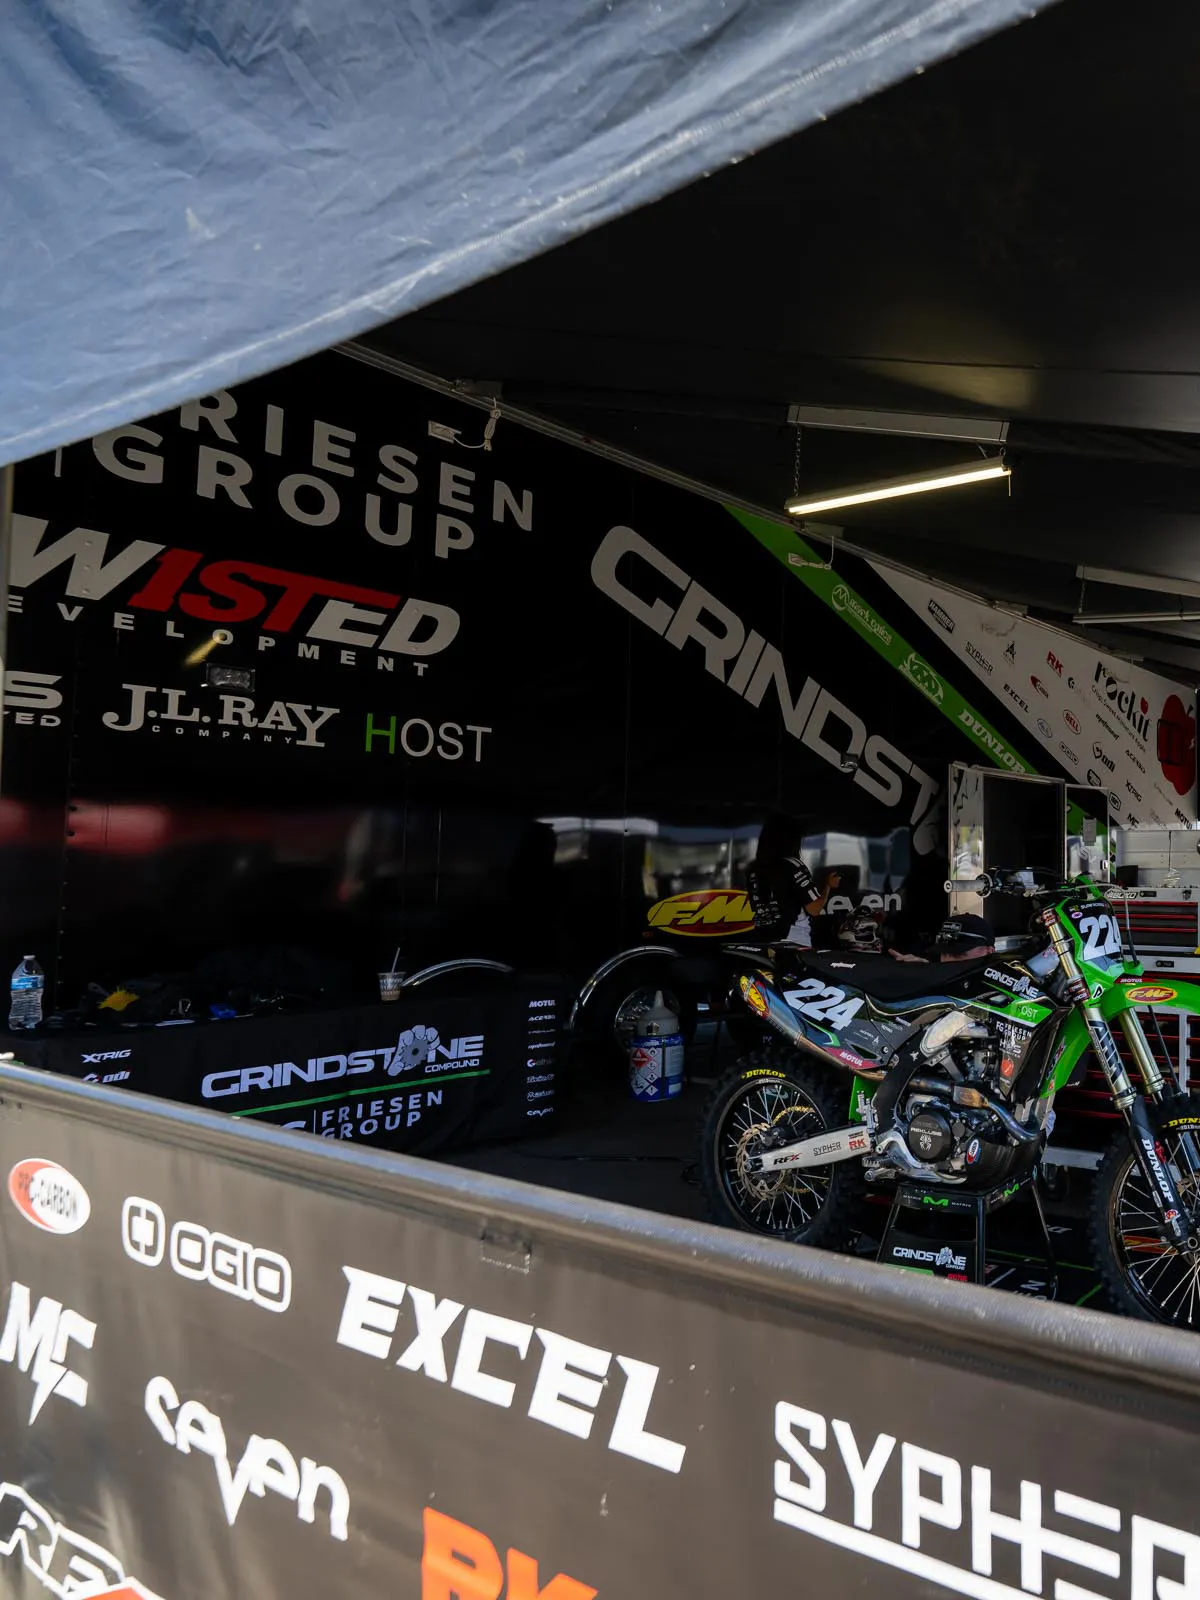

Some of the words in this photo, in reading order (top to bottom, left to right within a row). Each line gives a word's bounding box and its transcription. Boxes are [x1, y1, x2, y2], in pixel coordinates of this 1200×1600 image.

[93, 423, 475, 559] GROUP
[1003, 684, 1029, 713] EXCEL
[151, 724, 293, 745] COMPANY
[365, 713, 493, 763] HOST
[958, 709, 1027, 773] DUNLOP
[1129, 988, 1172, 1000] FMF
[528, 1000, 556, 1009] MOTUL
[782, 977, 865, 1032] 224
[81, 1049, 132, 1064] XTRIG
[424, 1057, 481, 1074] COMPOUND
[839, 1051, 863, 1067] MOTUL
[102, 1070, 131, 1083] odi
[746, 1068, 786, 1079] DUNLOP
[320, 1089, 444, 1127] FRIESEN
[320, 1110, 422, 1140] GROUP
[813, 1141, 842, 1157] SYPHER
[848, 1138, 866, 1149] RK
[773, 1152, 803, 1165] RFX
[1141, 1138, 1175, 1203] DUNLOP
[336, 1265, 687, 1474] EXCEL
